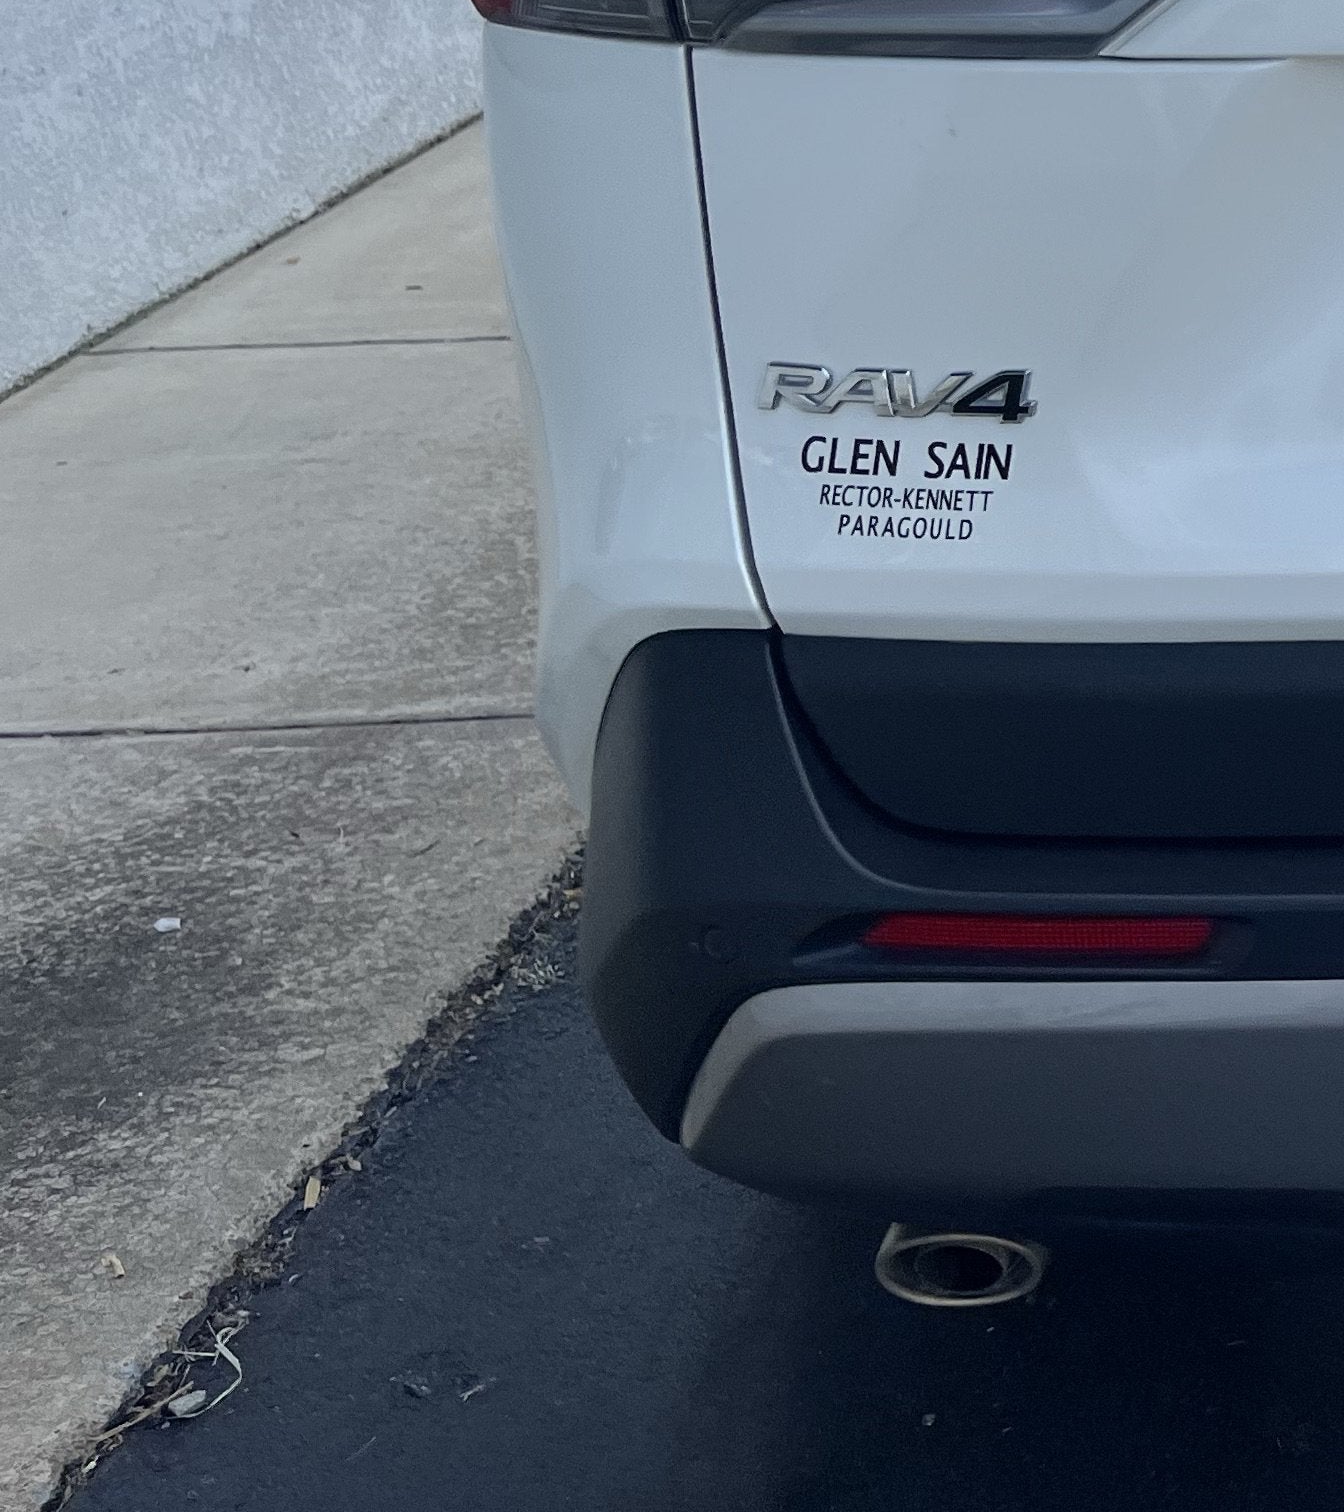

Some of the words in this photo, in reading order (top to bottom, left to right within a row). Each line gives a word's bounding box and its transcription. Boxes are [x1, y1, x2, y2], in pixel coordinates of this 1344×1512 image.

[758, 361, 1038, 424] RAV4
[801, 436, 900, 476] GLEN
[924, 442, 1014, 480] SAIN
[820, 485, 994, 512] RECTOR-KENNETT
[838, 515, 974, 540] PARAGOULD
